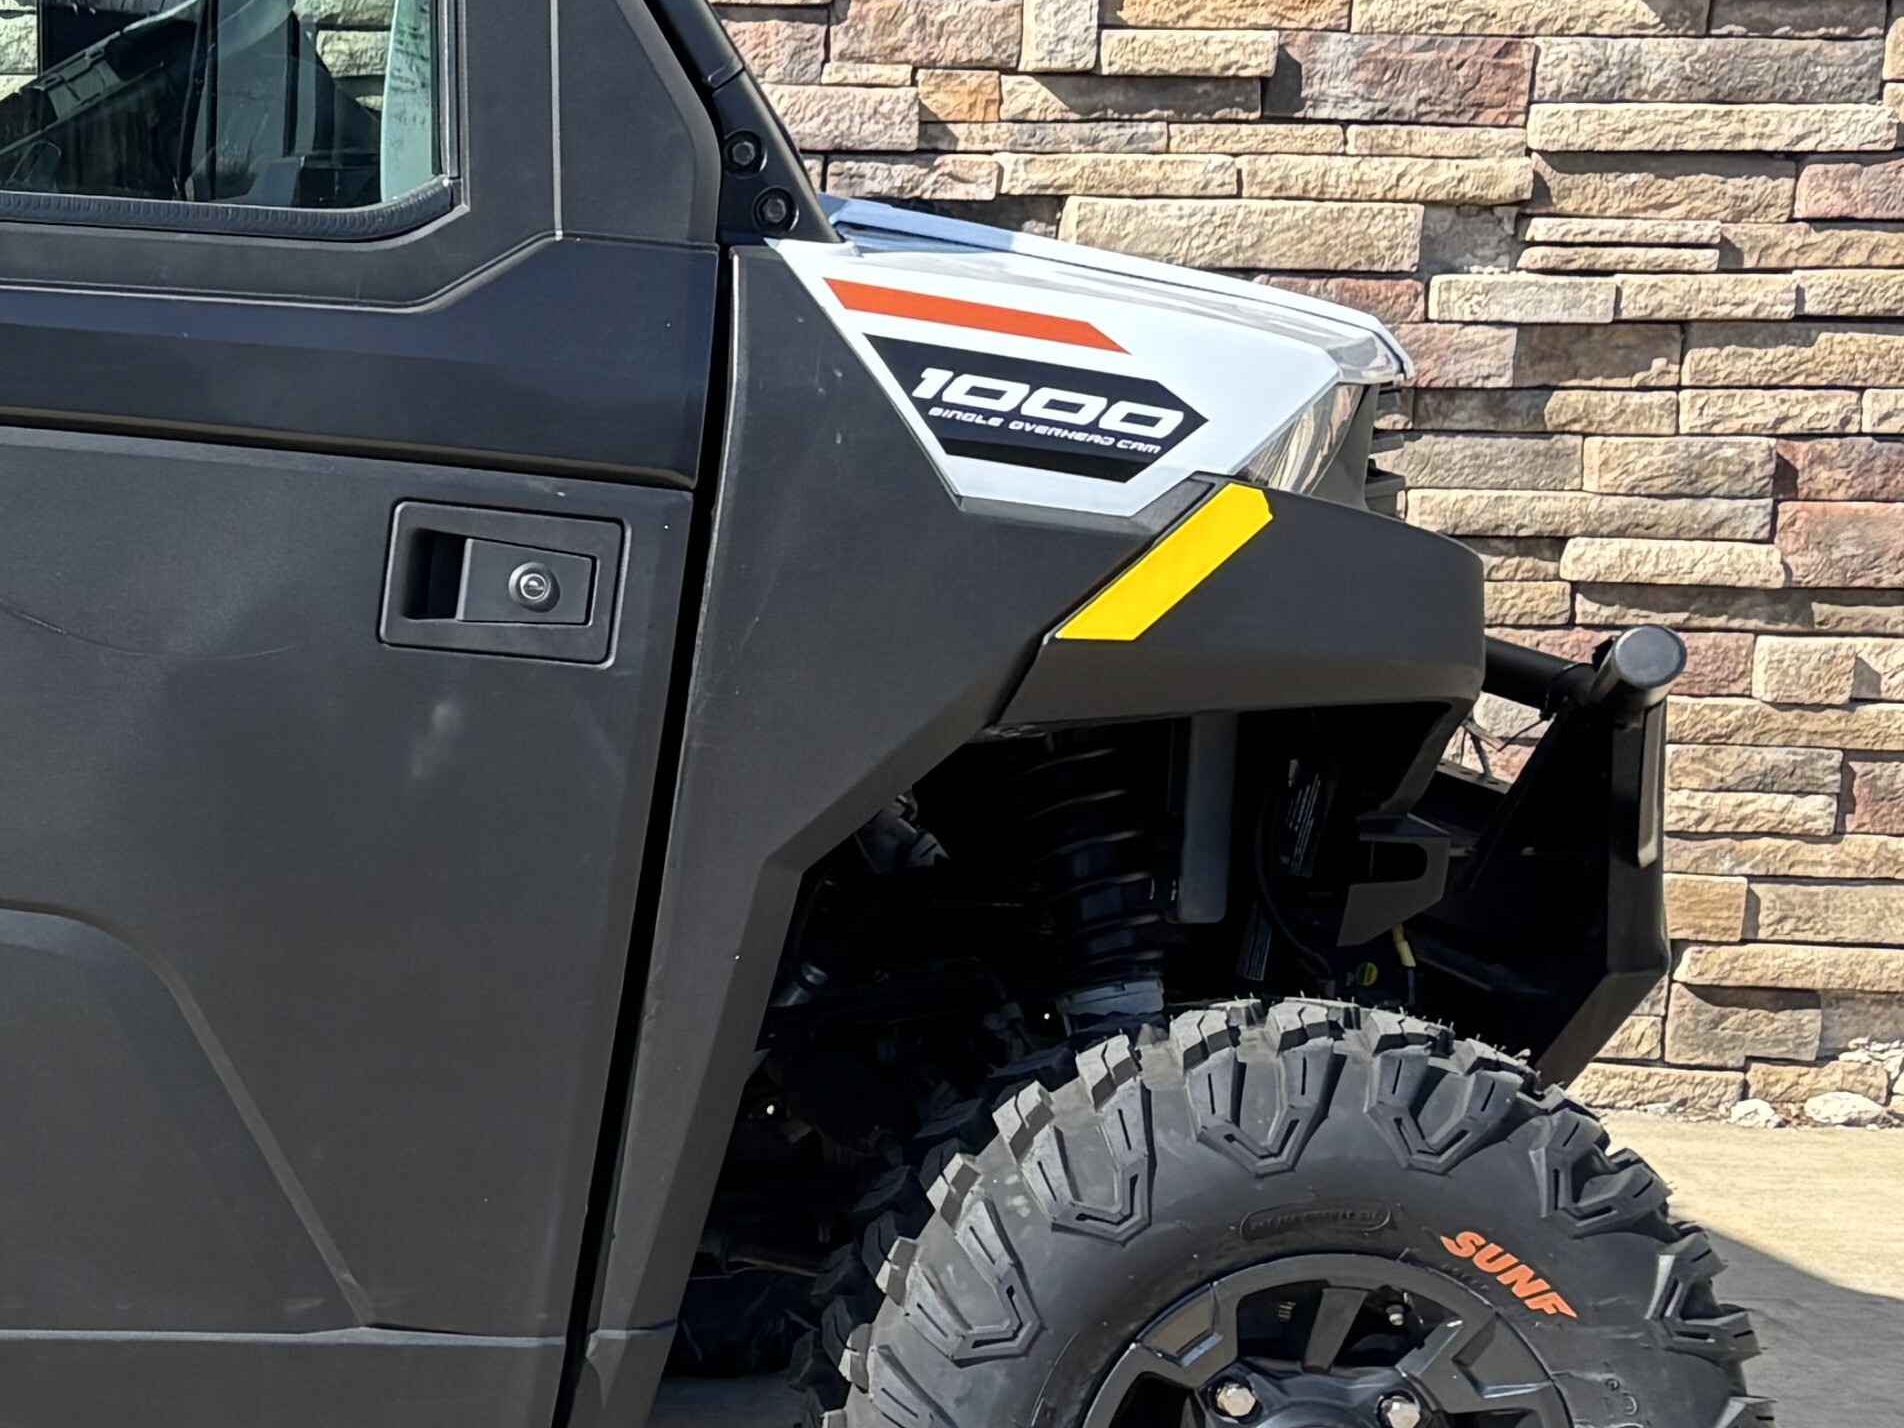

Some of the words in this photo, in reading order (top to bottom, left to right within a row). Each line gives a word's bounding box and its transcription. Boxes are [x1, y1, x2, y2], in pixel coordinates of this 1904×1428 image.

[912, 367, 1185, 439] 1000
[928, 406, 1004, 428] SINGLE
[1008, 420, 1116, 448] OVERHEAD
[1116, 438, 1162, 455] CAM
[1439, 1231, 1578, 1318] SUNF
